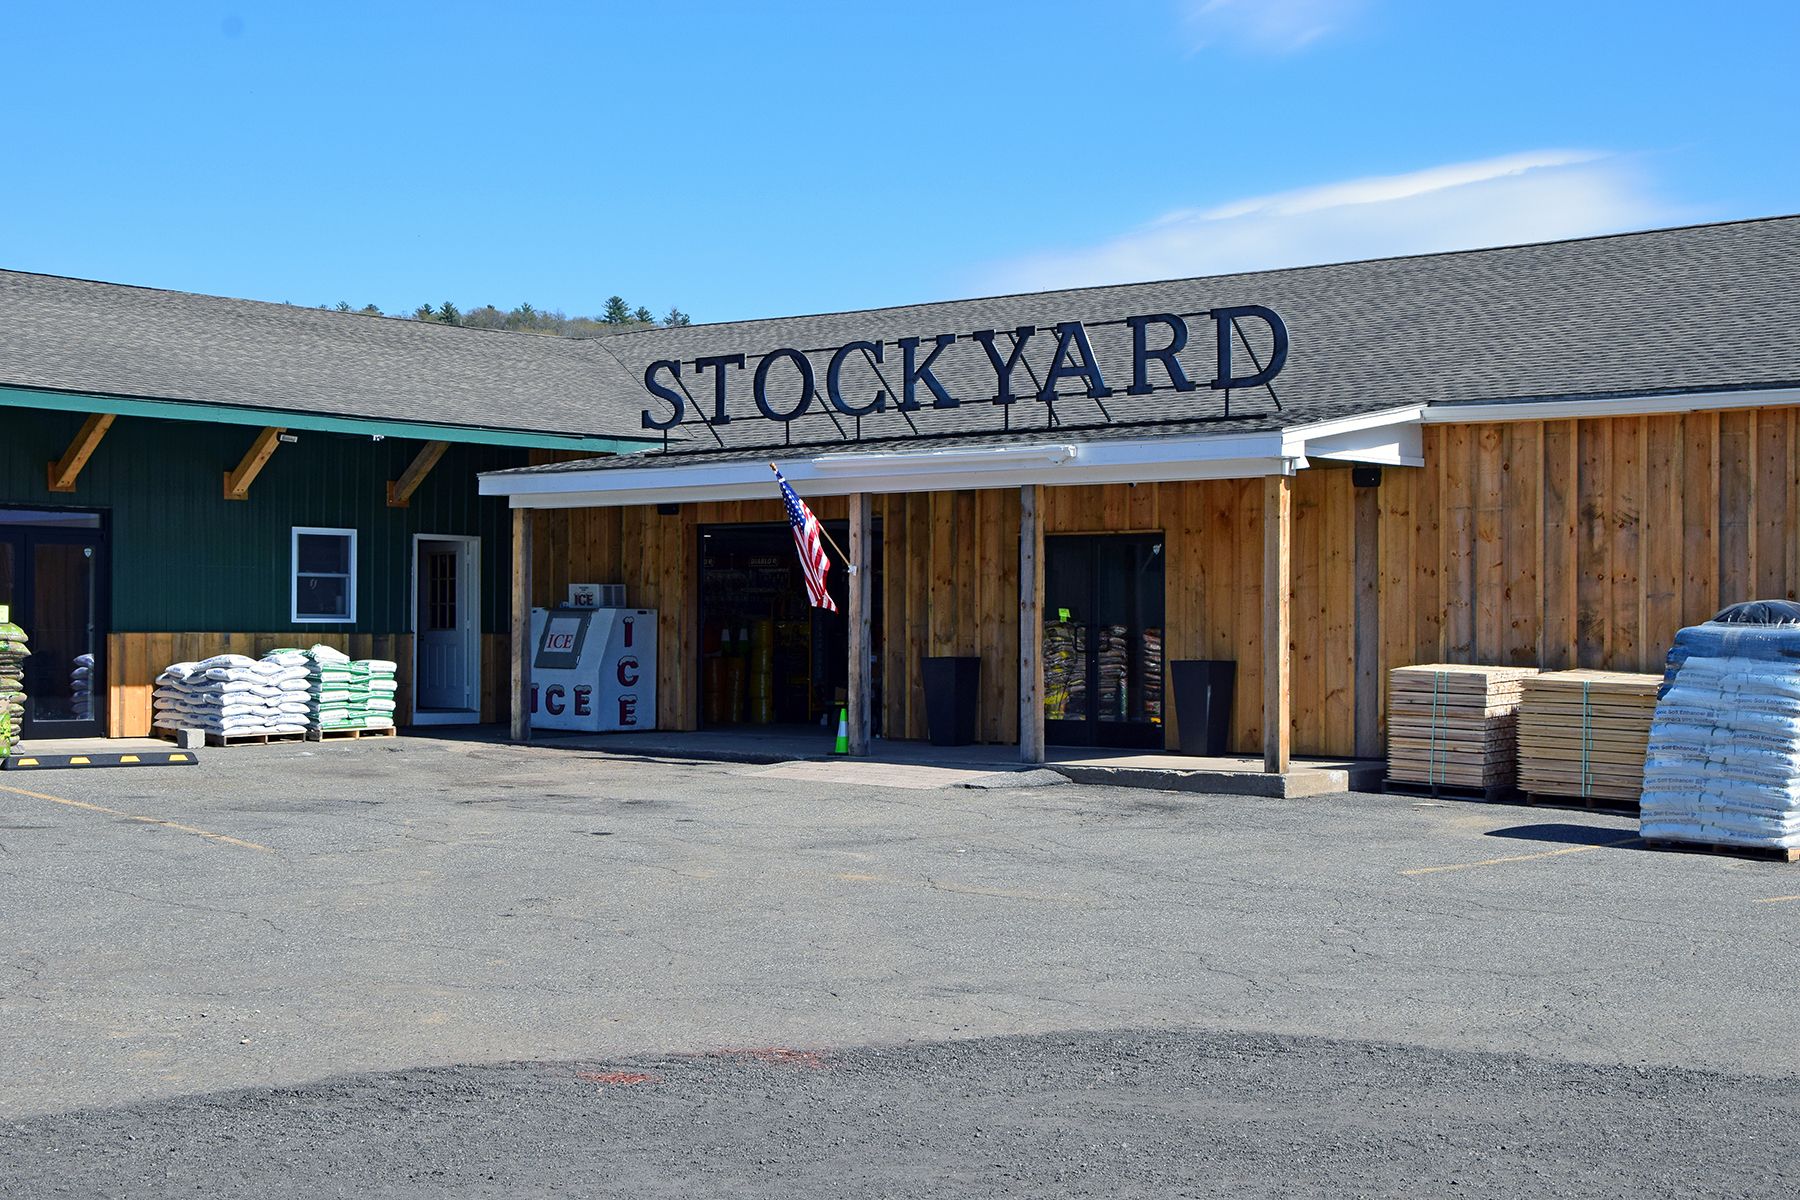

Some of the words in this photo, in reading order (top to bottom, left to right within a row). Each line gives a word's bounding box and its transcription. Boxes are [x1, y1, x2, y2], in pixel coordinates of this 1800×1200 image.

[641, 304, 1290, 431] STOCKYARD
[574, 592, 594, 606] ICE
[546, 633, 574, 649] ICE
